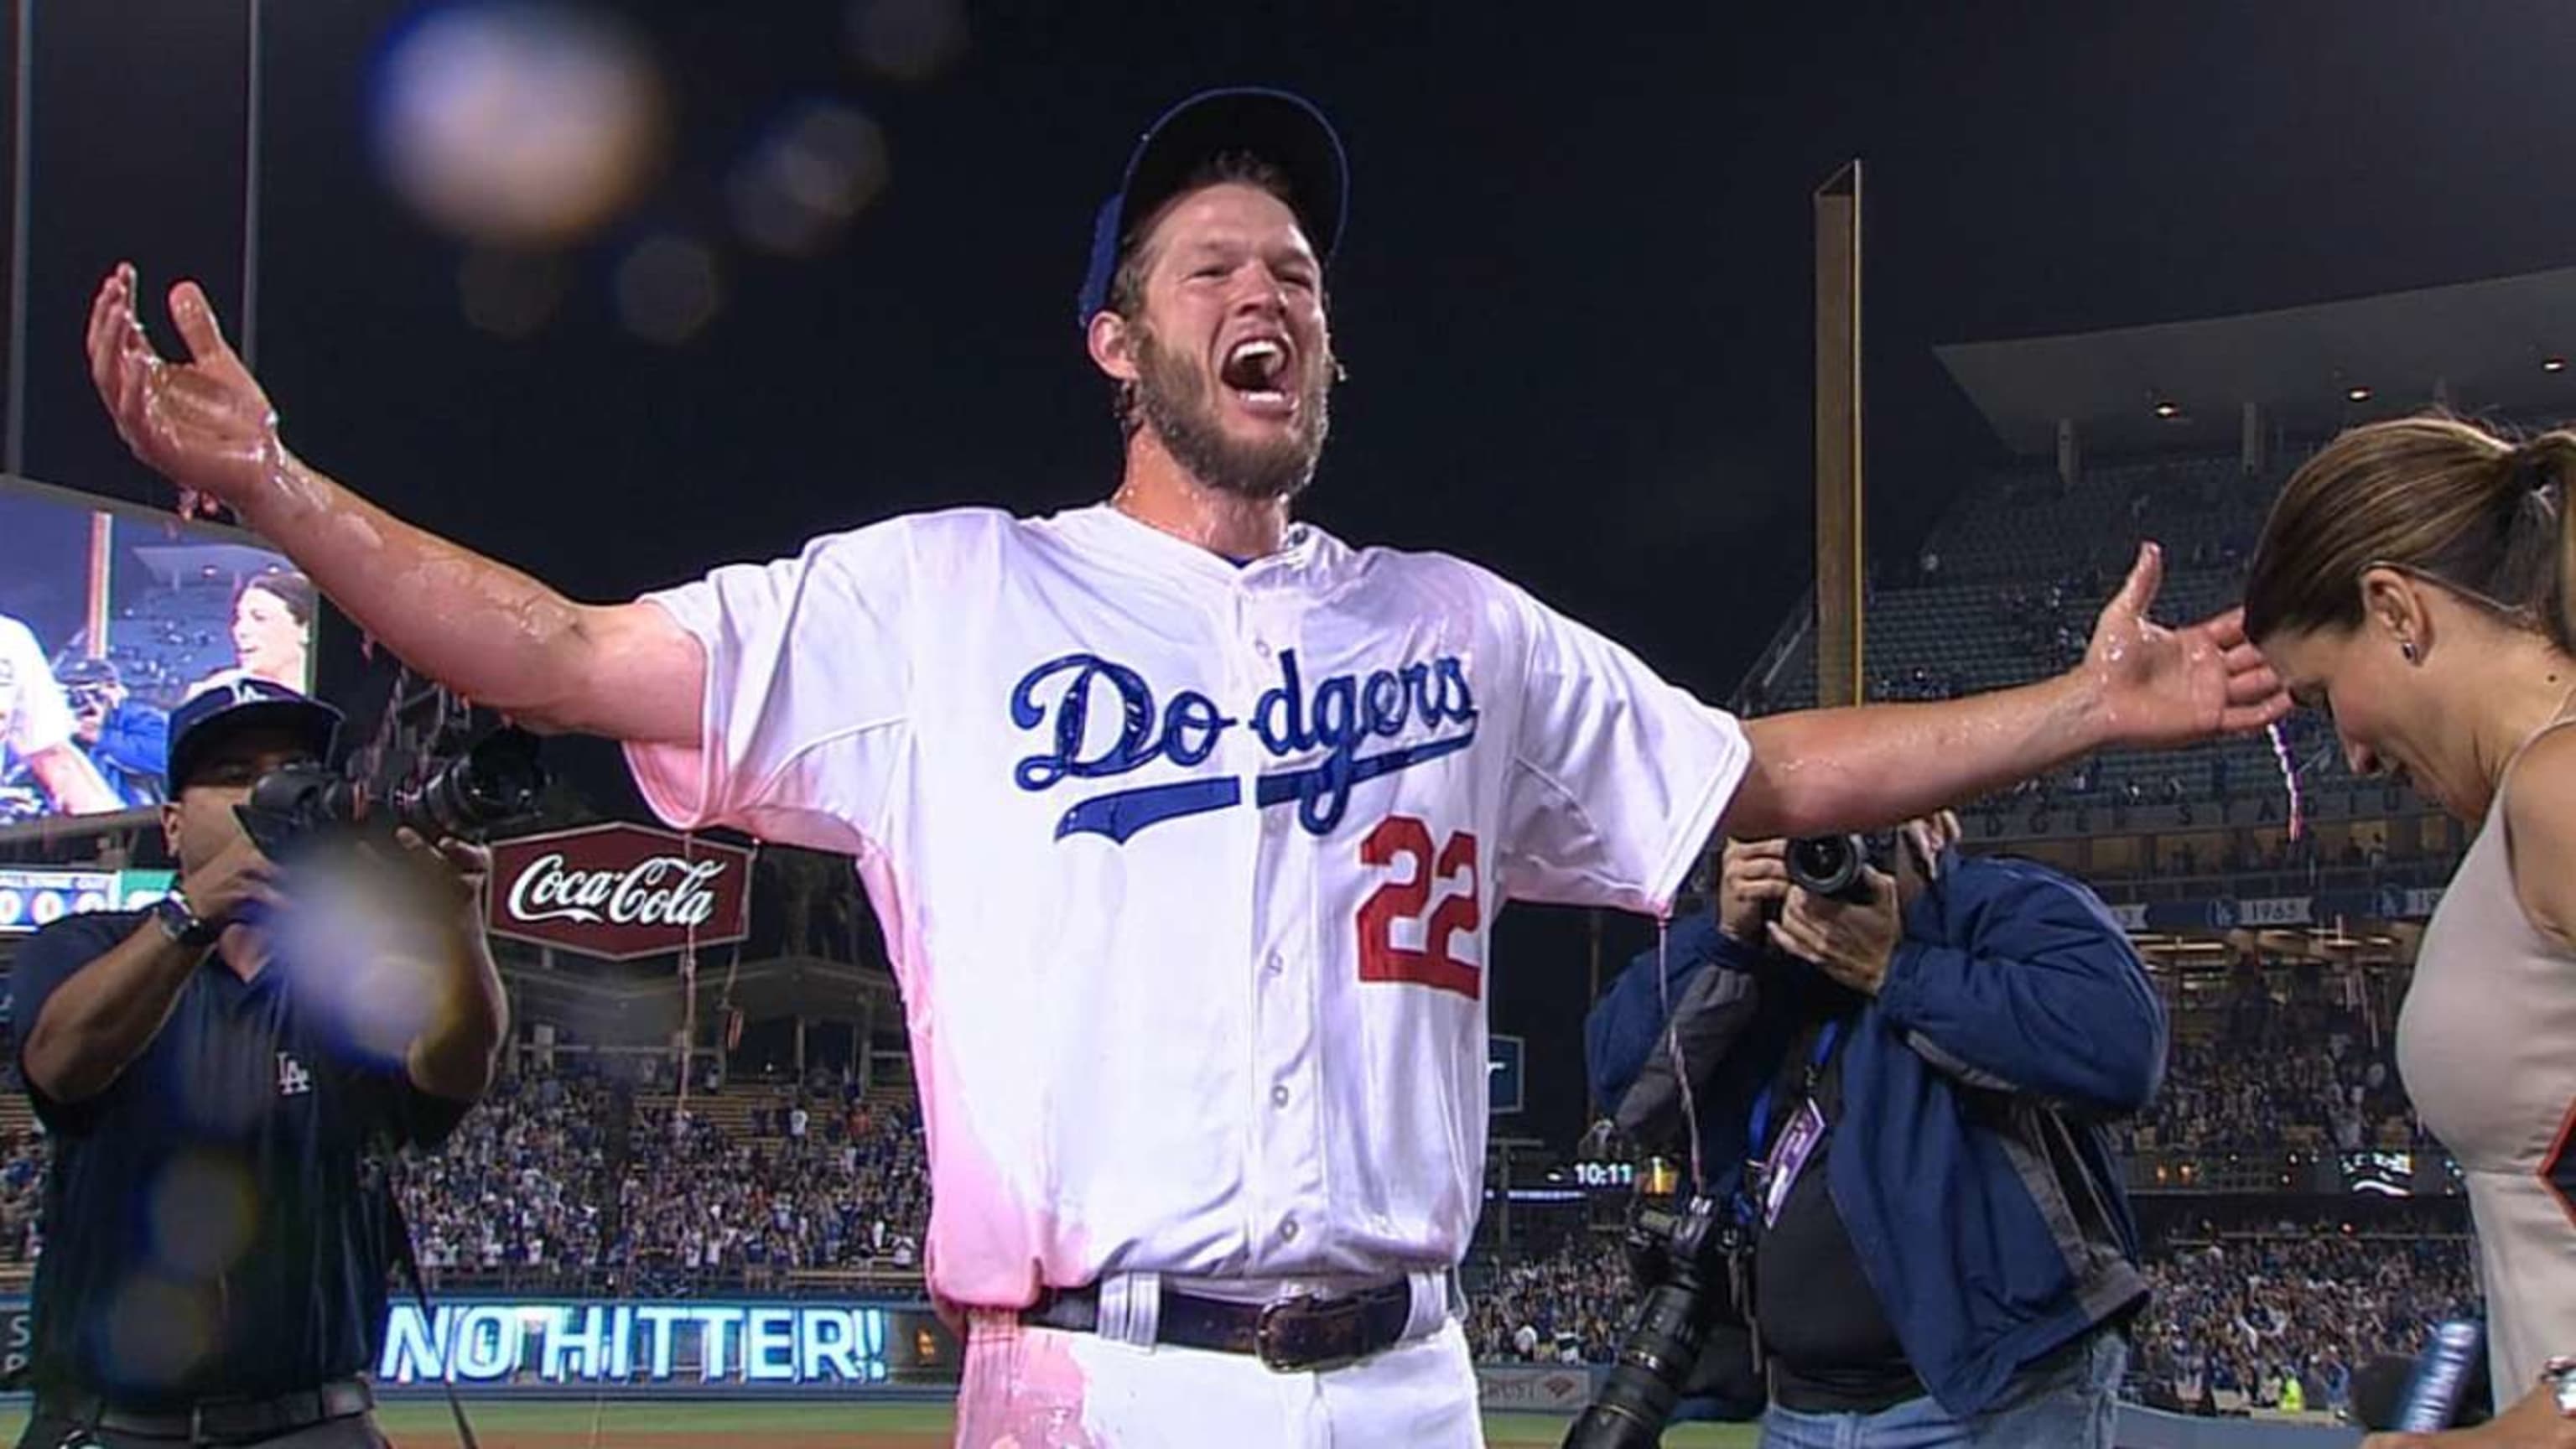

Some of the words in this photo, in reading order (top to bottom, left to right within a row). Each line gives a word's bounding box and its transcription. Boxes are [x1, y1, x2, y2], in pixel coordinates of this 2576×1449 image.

[1010, 648, 1479, 837] Dodgers
[508, 854, 726, 923] Coca-Cola
[1357, 815, 1481, 1000] 22
[276, 1052, 309, 1095] LA
[1575, 1163, 1633, 1185] 10:11
[380, 1305, 515, 1383] NO
[541, 1305, 886, 1383] HITTER!!
